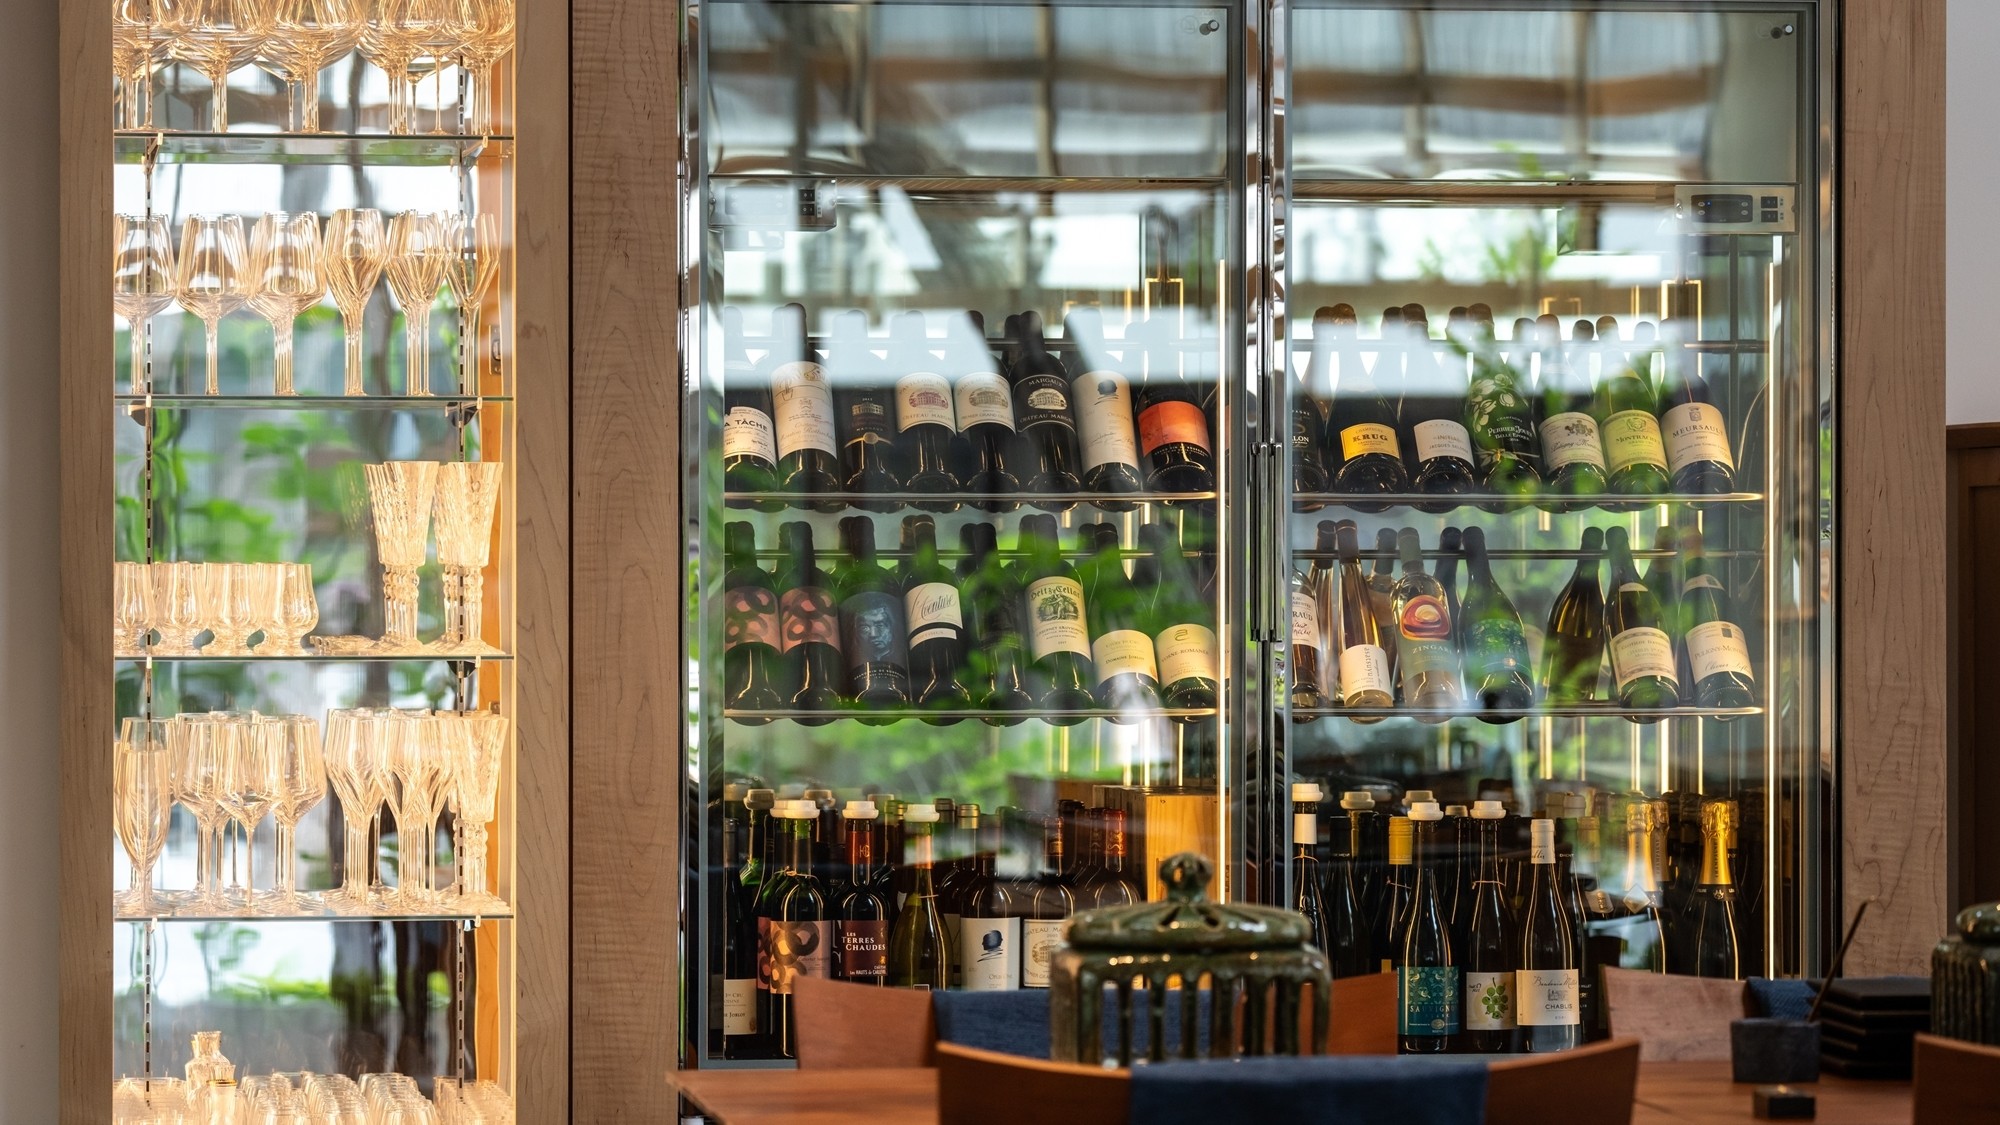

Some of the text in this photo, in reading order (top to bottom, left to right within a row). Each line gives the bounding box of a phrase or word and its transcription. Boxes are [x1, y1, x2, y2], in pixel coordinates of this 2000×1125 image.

[1028, 378, 1063, 388] MARGAUX
[735, 419, 768, 433] TÂCHE
[1673, 425, 1723, 439] MEURSAULT
[1352, 433, 1388, 442] KRUG
[1292, 611, 1313, 621] RAUD
[841, 936, 875, 944] TERRES
[845, 943, 886, 951] CHAUDES
[1409, 1004, 1456, 1013] SAUVIGNO
